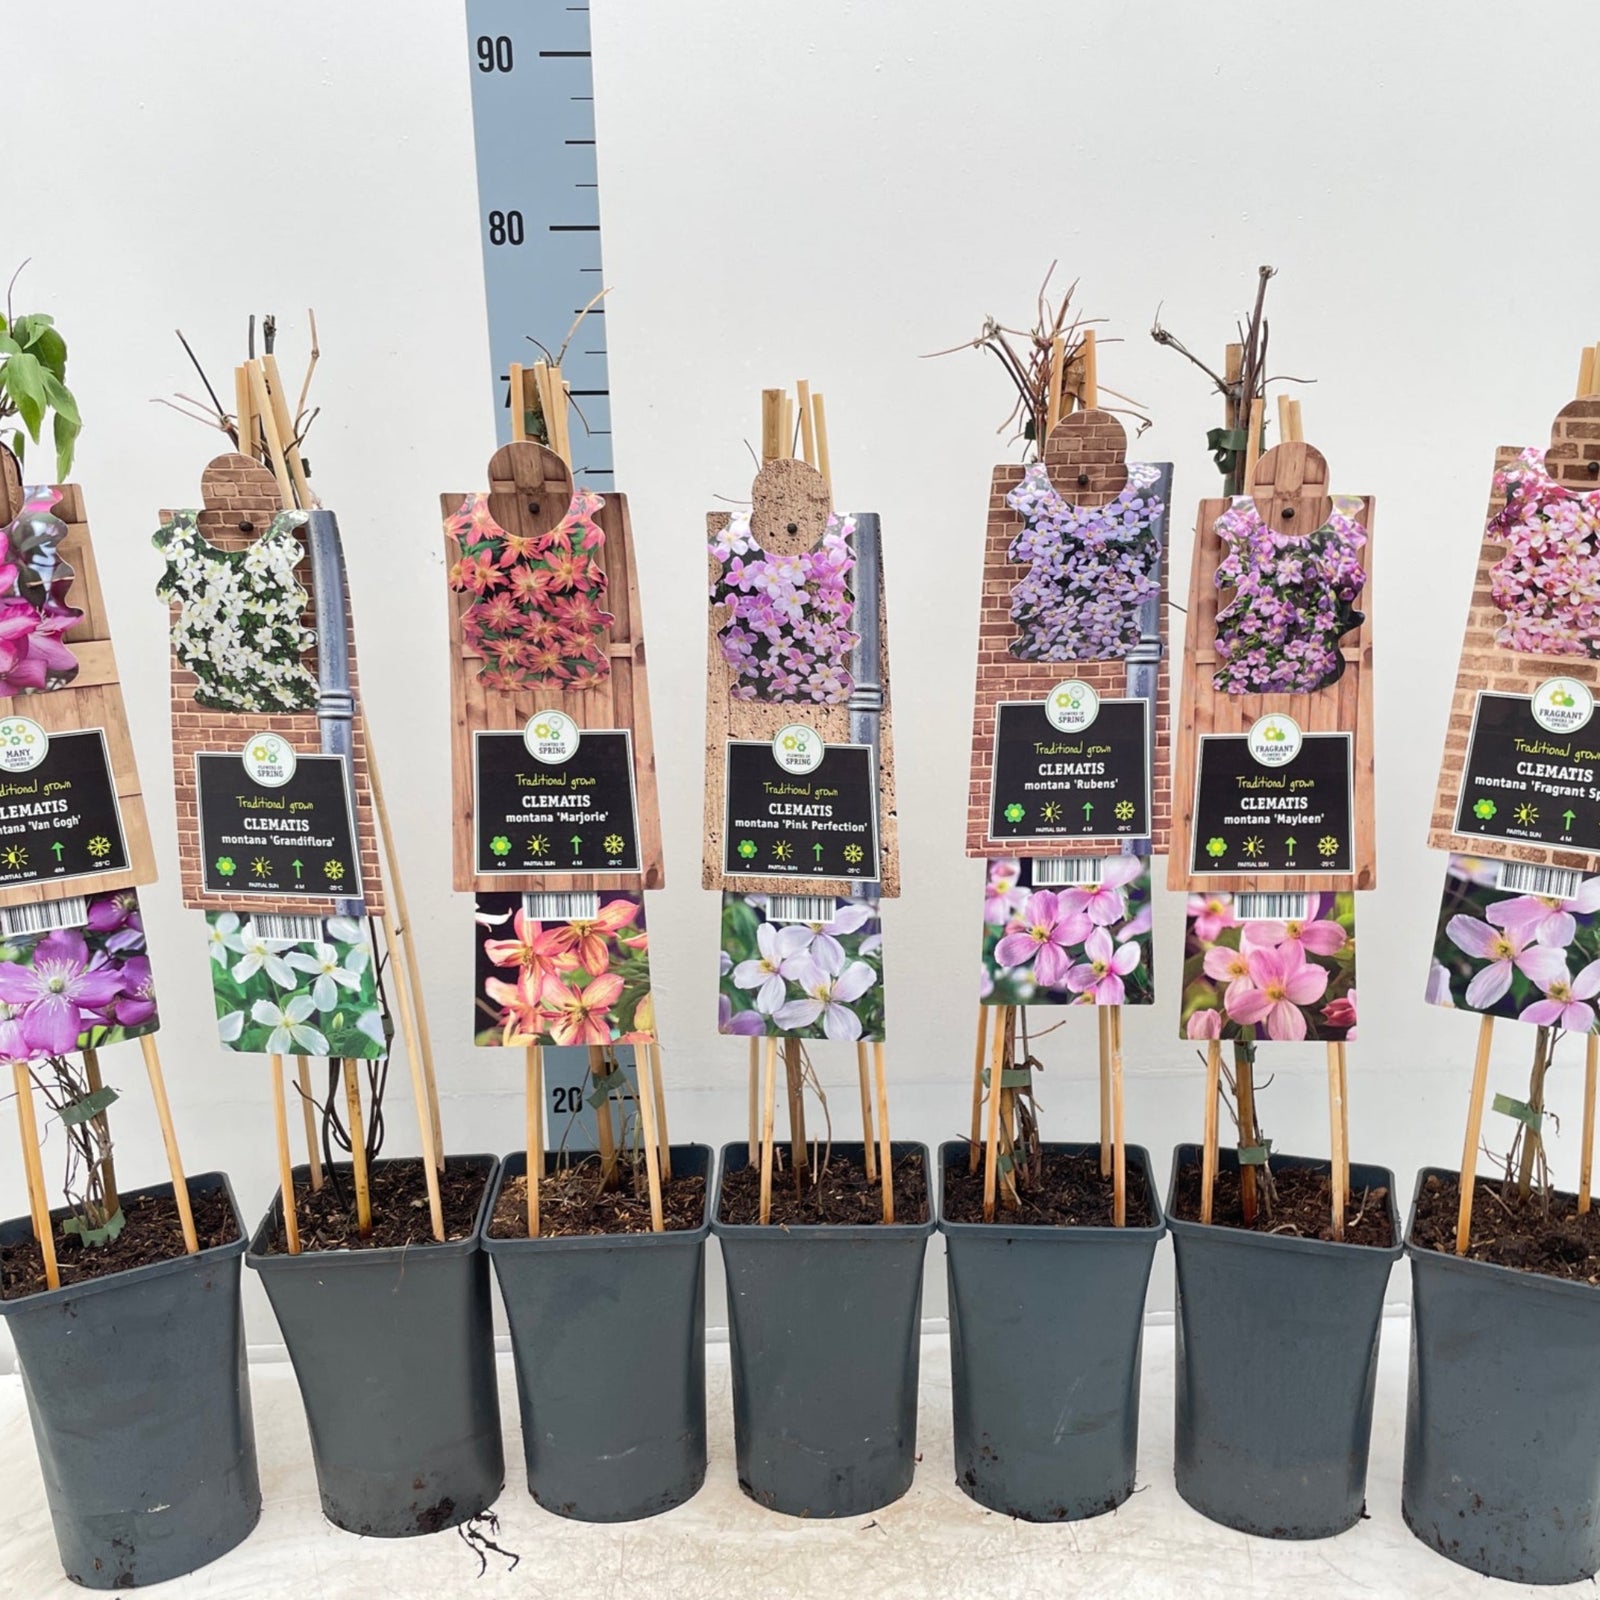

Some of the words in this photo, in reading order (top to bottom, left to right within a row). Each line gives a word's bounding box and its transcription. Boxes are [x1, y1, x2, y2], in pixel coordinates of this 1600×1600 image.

[477, 35, 513, 73] 90
[489, 210, 524, 246] 80
[1058, 716, 1085, 724] SPRING
[1539, 709, 1583, 720] FRAGRANT
[6, 749, 31, 758] MANY
[1034, 741, 1083, 754] Traditional
[1087, 746, 1111, 757] grown
[1514, 739, 1570, 756] Traditional
[1039, 762, 1104, 775] CLEMATIS
[1517, 762, 1593, 782] CLEMATIS
[515, 772, 566, 786] Traditional
[571, 778, 595, 789] grown
[1025, 781, 1070, 790] montana
[1074, 779, 1118, 789] 'Rubens'
[1236, 775, 1286, 789] Traditional
[1290, 780, 1314, 792] grown
[1475, 776, 1526, 790] montana
[1532, 782, 1584, 797] 'Fragrant
[44, 781, 71, 796] grown
[763, 782, 810, 796] Traditional
[815, 788, 838, 800] grown
[236, 796, 285, 809] Traditional
[290, 803, 313, 813] grown
[522, 795, 590, 808] CLEMATIS
[1241, 797, 1308, 810] CLEMATIS
[769, 803, 832, 816] CLEMATIS
[28, 821, 50, 831] 'Van
[53, 815, 81, 828] Gogh'
[244, 818, 309, 831] CLEMATIS
[506, 814, 553, 822] montana
[557, 812, 608, 824] 'Marjorie'
[1224, 815, 1270, 824] montana
[1274, 813, 1324, 826] 'Mayleen'
[735, 820, 779, 829] montana
[782, 820, 808, 829] 'Pink
[812, 821, 867, 832] Perfection'
[222, 835, 267, 845] montana
[270, 835, 335, 847] 'Grandiflora'
[553, 1087, 582, 1113] 20
